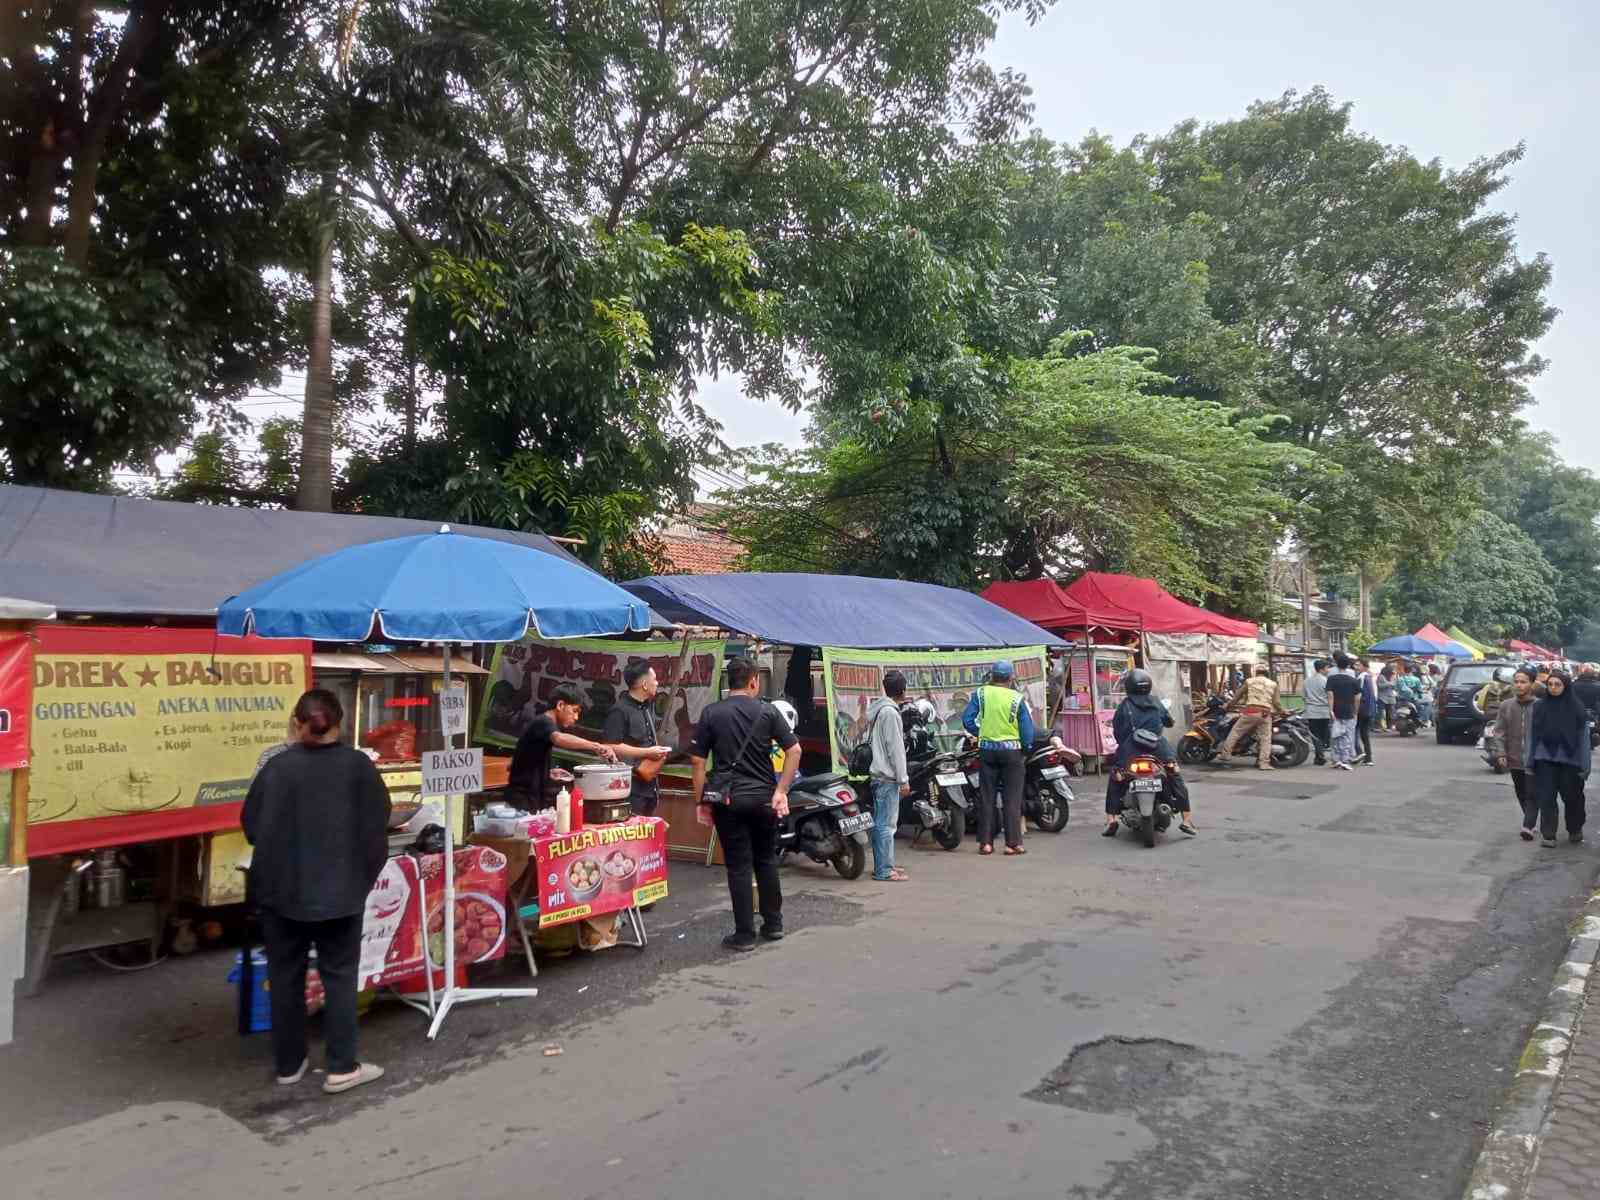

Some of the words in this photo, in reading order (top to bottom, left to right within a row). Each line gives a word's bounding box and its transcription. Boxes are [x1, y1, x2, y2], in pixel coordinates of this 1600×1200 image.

[35, 701, 136, 720] GORENGAN
[158, 697, 209, 715] ANEKA
[215, 696, 285, 713] MINUMAN
[62, 727, 97, 739] Gehu
[163, 725, 177, 736] Es
[64, 742, 128, 755] Bala-Bala
[165, 738, 192, 751] Kopi
[66, 759, 83, 771] dll
[432, 751, 474, 770] BAKSO
[425, 774, 480, 793] MERCON
[598, 823, 656, 845] DIMSUM
